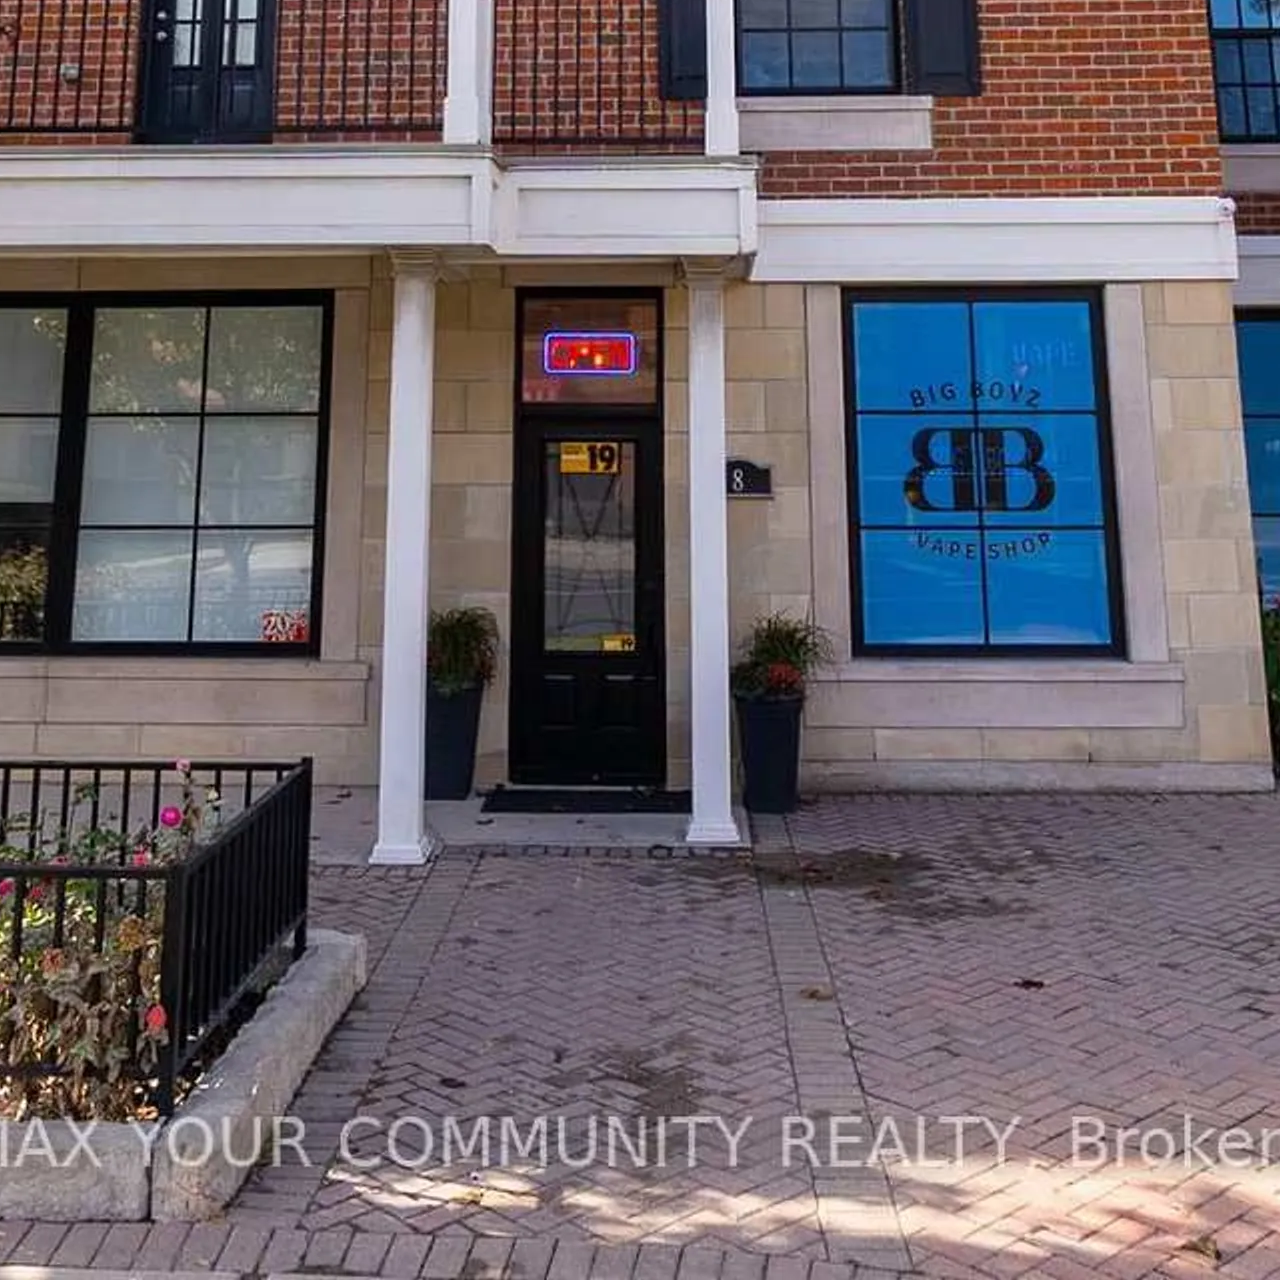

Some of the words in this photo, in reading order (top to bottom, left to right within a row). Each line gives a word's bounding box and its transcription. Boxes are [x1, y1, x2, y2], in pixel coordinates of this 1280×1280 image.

[910, 382, 957, 408] BIG
[971, 381, 1041, 408] BOYZ
[587, 444, 615, 471] 19
[732, 468, 744, 491] 8
[916, 532, 976, 560] VAPE
[988, 532, 1050, 560] SHOP
